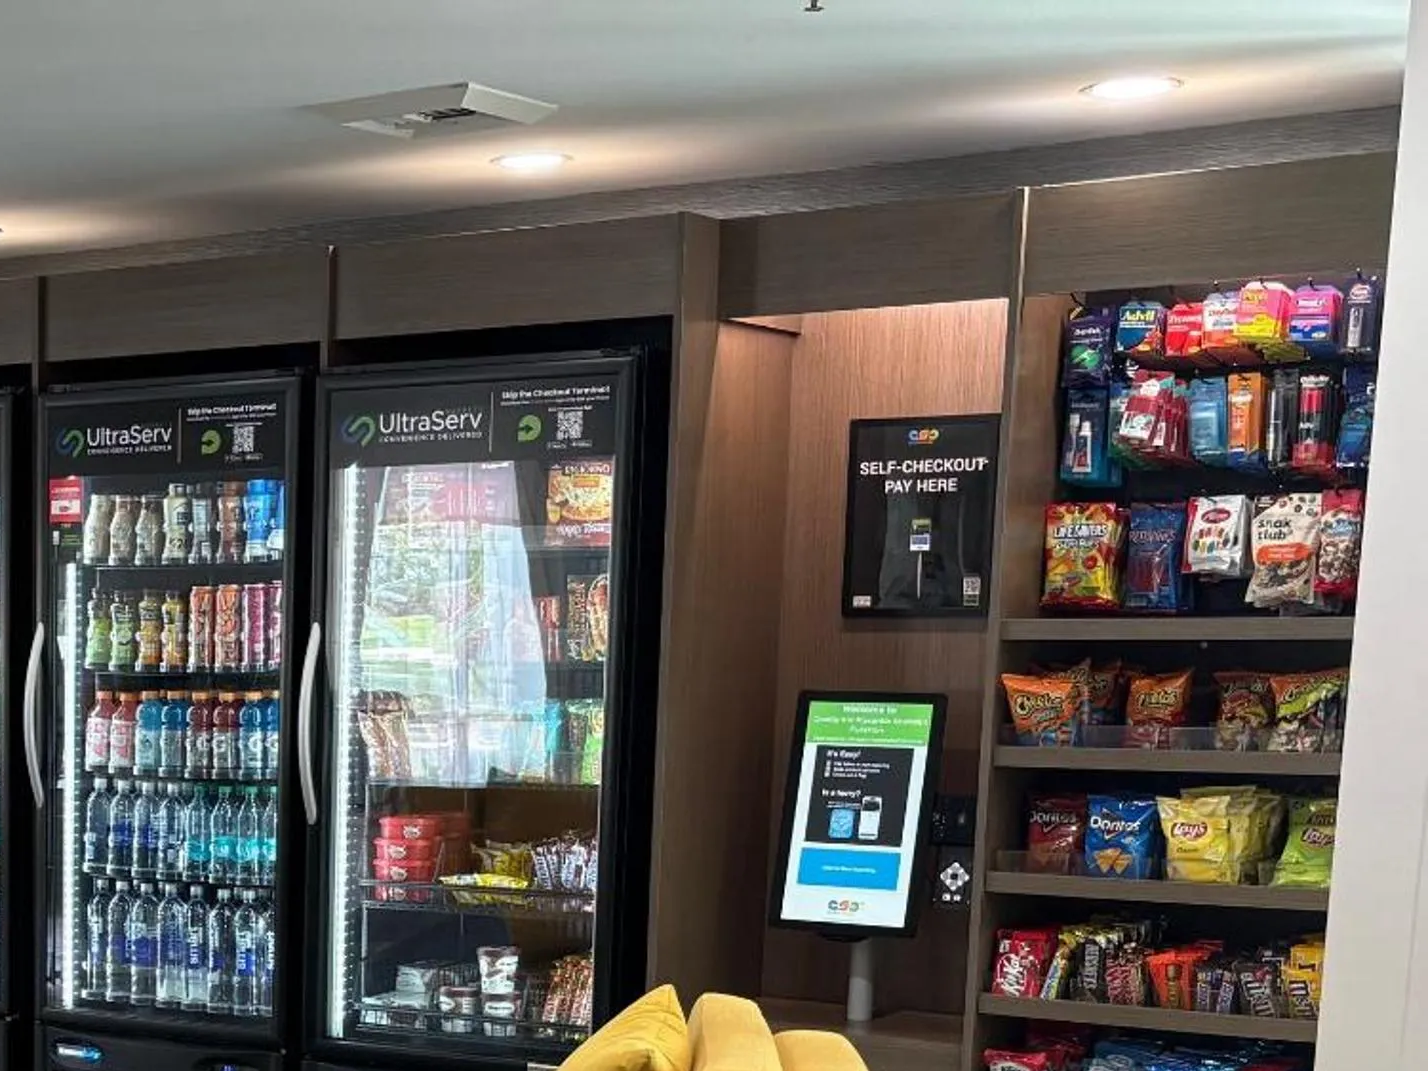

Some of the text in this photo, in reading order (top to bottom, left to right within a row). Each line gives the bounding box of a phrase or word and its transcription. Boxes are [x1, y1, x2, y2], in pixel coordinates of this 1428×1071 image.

[378, 410, 483, 434] UltraServ
[86, 425, 172, 447] UltraServ
[860, 456, 988, 476] SELF-CHECKOUT
[885, 477, 958, 494] PAY HERE
[1090, 814, 1142, 832] Doritos
